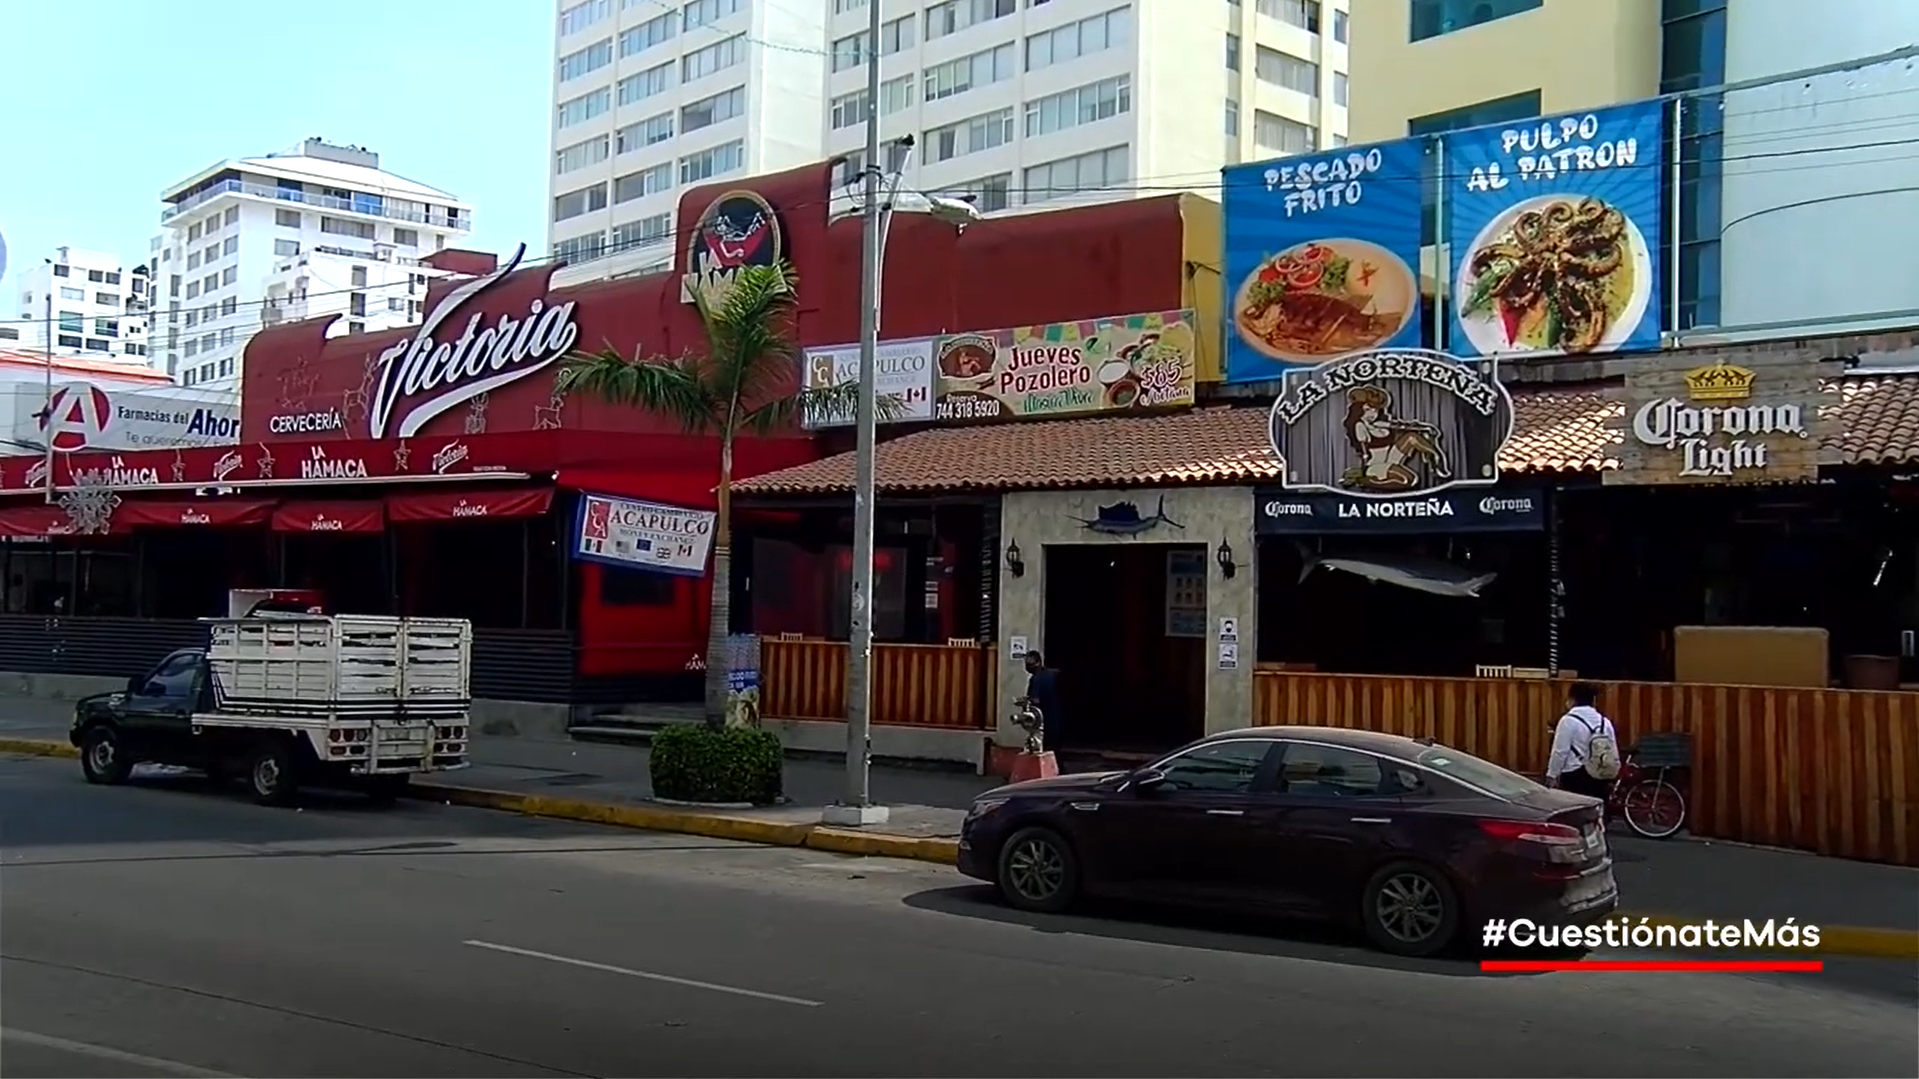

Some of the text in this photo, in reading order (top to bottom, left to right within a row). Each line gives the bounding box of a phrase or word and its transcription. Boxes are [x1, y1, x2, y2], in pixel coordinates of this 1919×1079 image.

[1501, 114, 1598, 153] PULPO
[1264, 147, 1381, 192] PESCADO
[1467, 138, 1637, 192] AL PATRON
[1284, 180, 1361, 217] FRITO
[371, 242, 578, 438] Victoria
[1009, 346, 1082, 370] Jueves
[1001, 366, 1090, 394] Pozolero
[1277, 353, 1499, 424] LA NORTEÑA
[118, 406, 170, 423] Farmacias
[173, 412, 188, 425] del
[270, 406, 342, 434] CERVECERÍA
[936, 400, 1000, 419] 744 318 5920
[1633, 397, 1805, 449] Corona
[112, 456, 124, 468] LA
[311, 446, 326, 460] LA
[1679, 438, 1768, 476] Light
[301, 459, 368, 479] HAMACA
[1266, 501, 1313, 517] Corona
[1338, 498, 1455, 518] LA NORTEÑA
[1478, 496, 1534, 515] Corona
[610, 510, 708, 535] ACAPULCO
